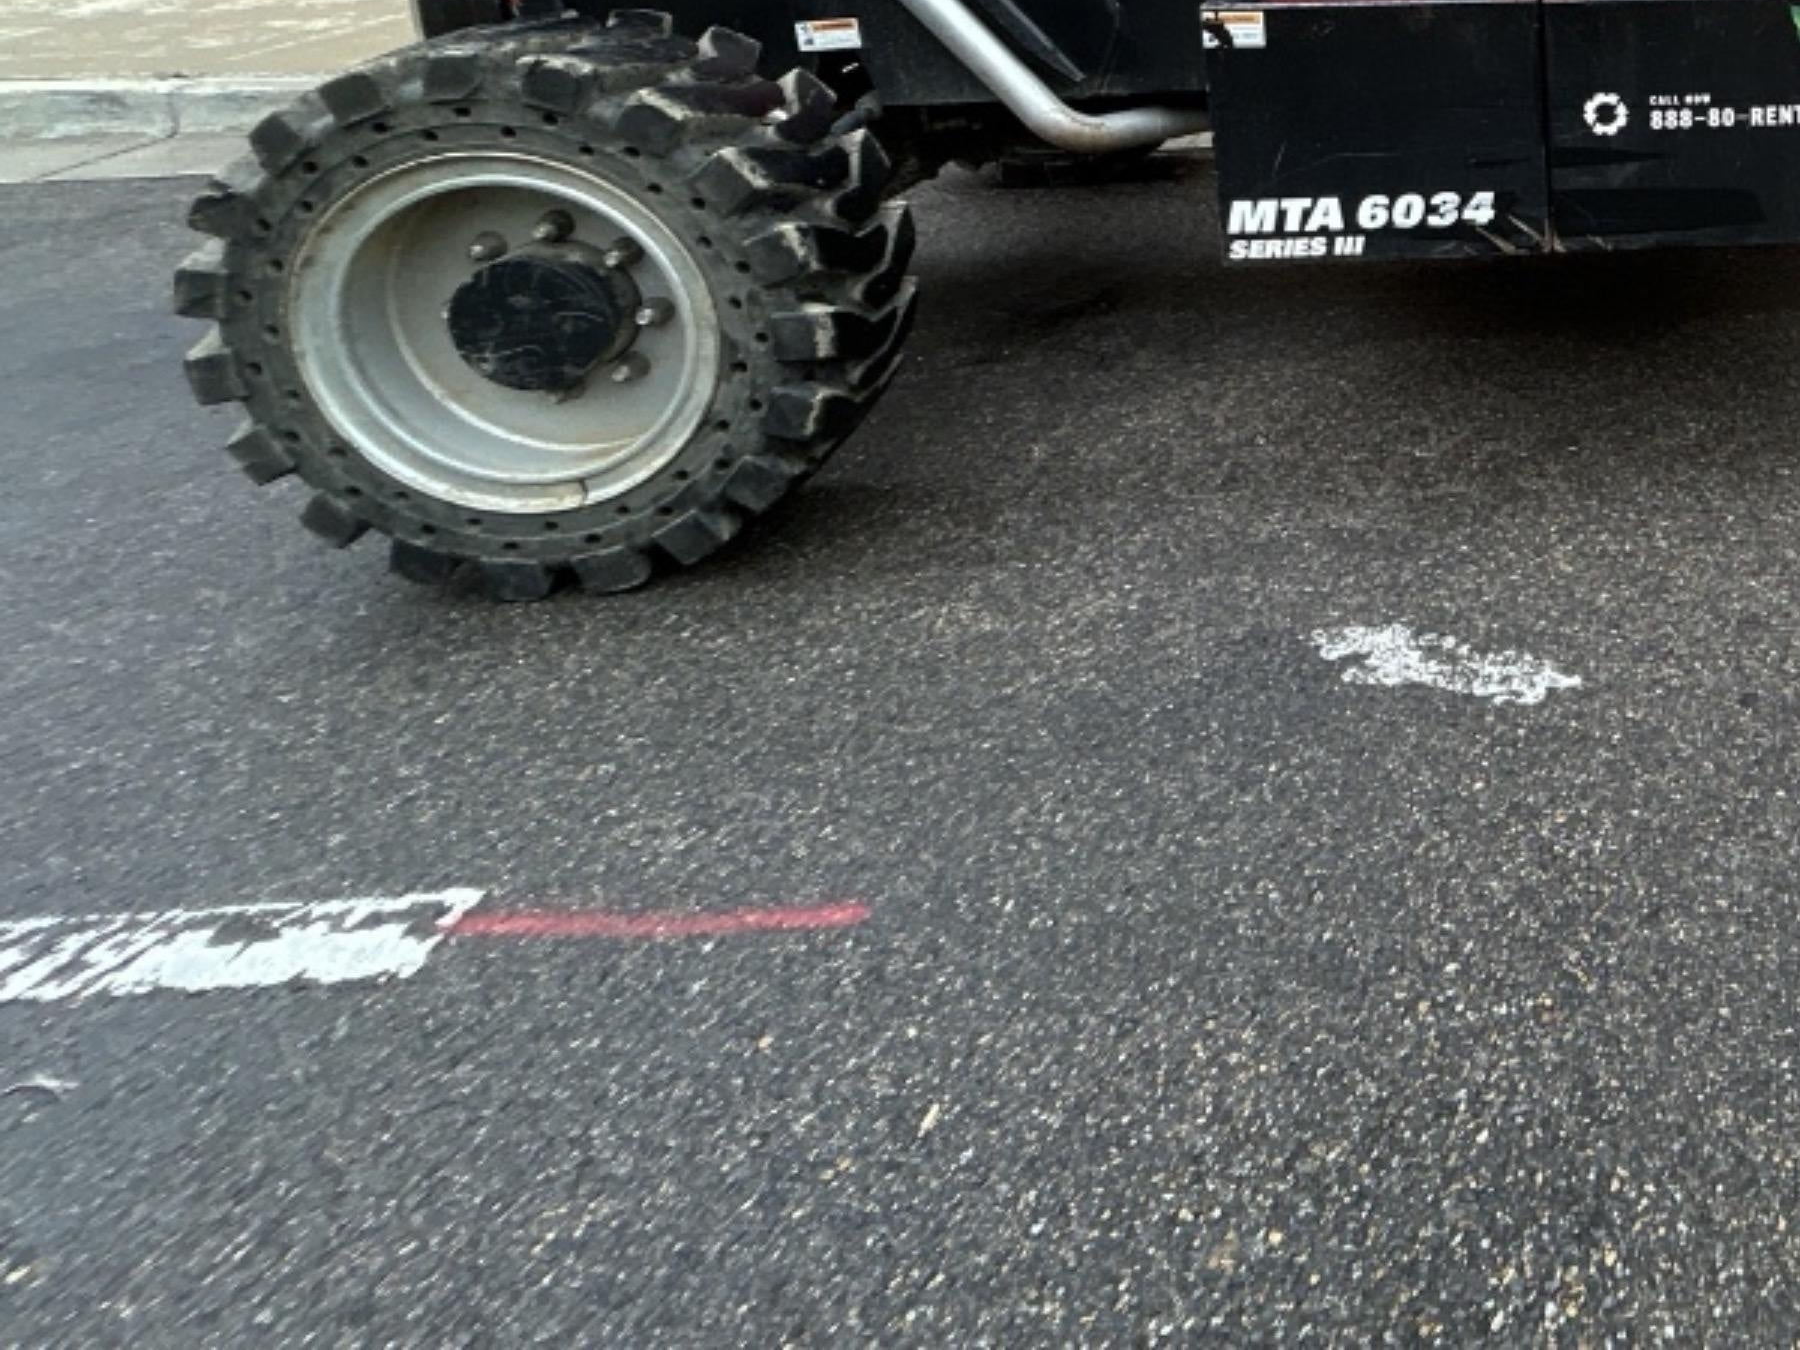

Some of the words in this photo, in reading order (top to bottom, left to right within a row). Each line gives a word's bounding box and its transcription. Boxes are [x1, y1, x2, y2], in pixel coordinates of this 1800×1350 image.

[1227, 197, 1345, 234] MTA
[1356, 191, 1496, 229] 6034
[1228, 236, 1328, 259] SERIES
[1333, 234, 1366, 256] III
